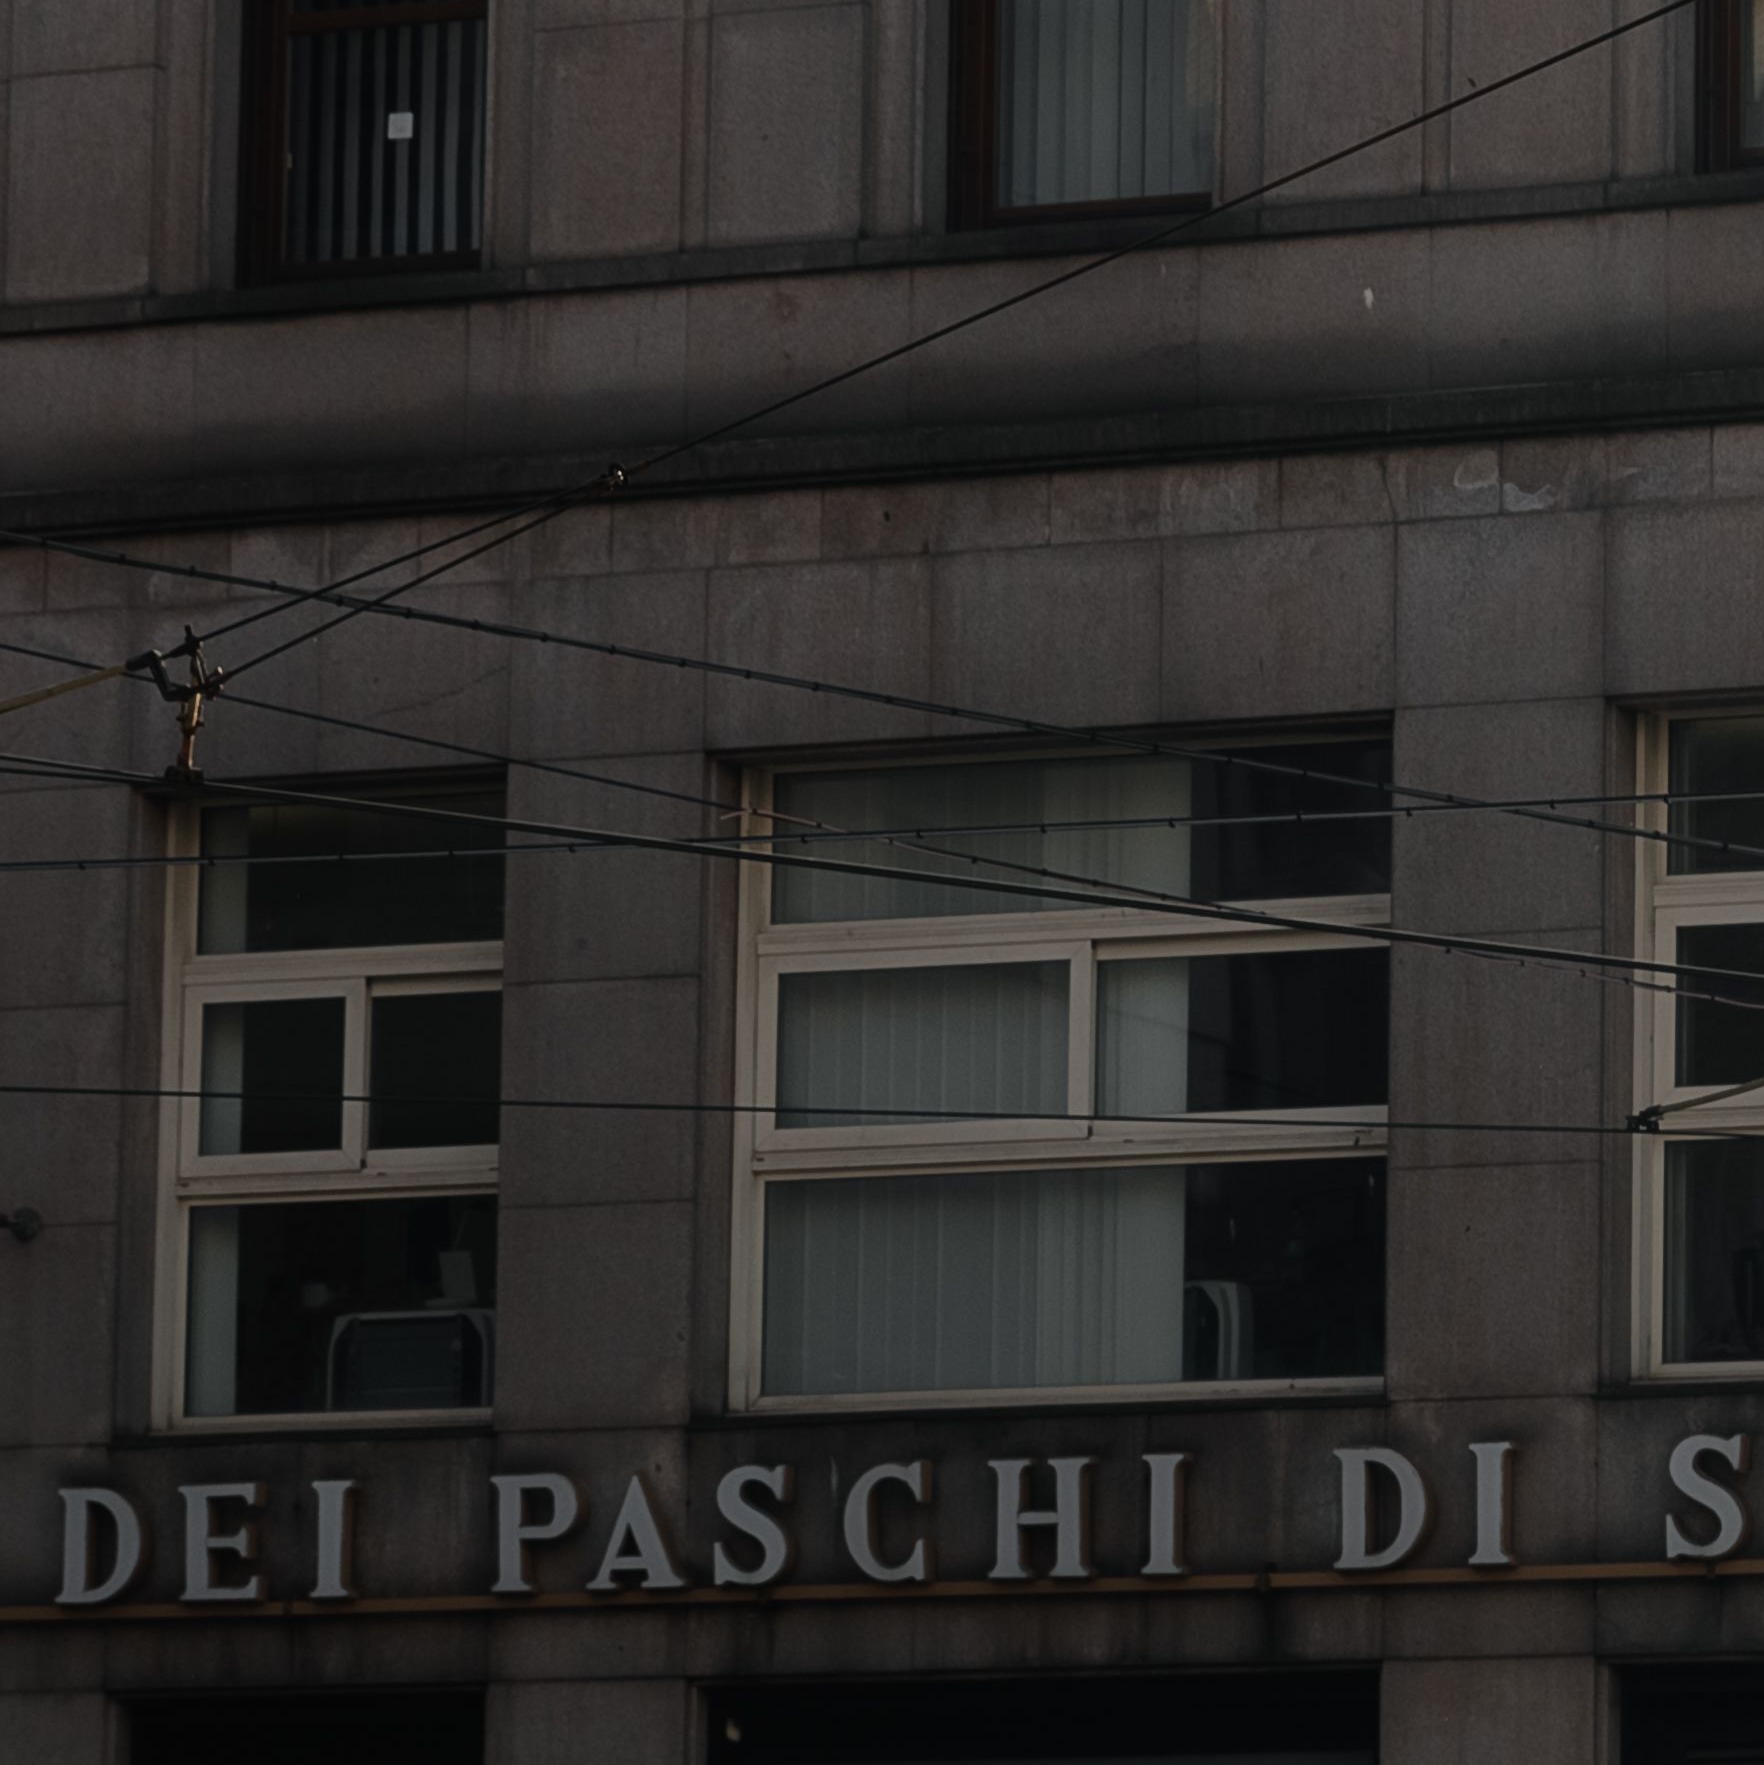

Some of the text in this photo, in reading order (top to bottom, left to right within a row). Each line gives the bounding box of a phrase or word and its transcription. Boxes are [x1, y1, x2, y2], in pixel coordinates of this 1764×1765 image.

[56, 1477, 360, 1606] DEI
[490, 1452, 1196, 1594] PASCHI
[1332, 1441, 1518, 1570] DI
